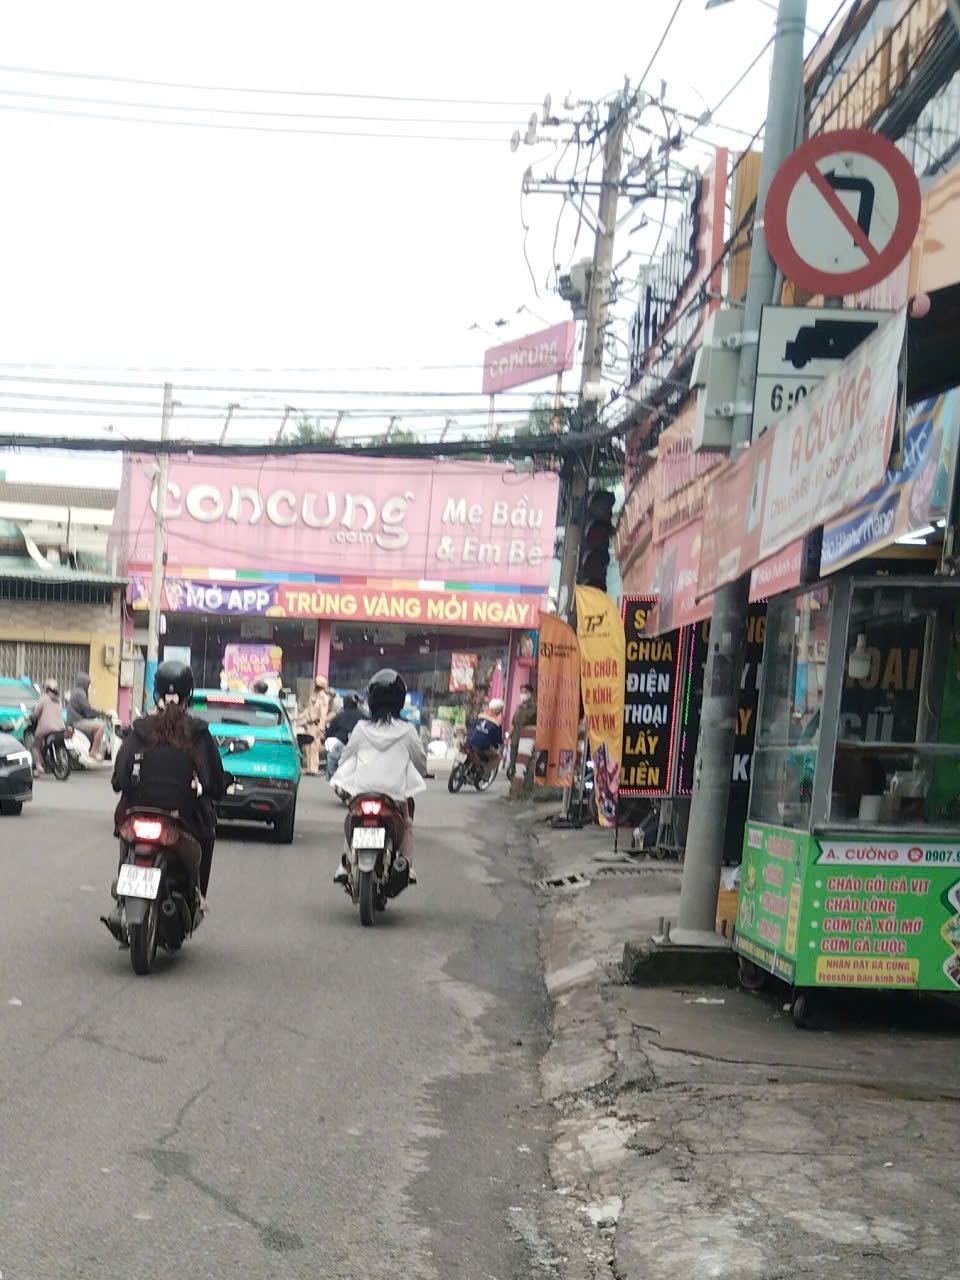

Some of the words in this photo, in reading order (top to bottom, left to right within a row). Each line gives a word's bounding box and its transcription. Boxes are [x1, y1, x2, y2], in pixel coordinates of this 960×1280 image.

[442, 497, 482, 533] Mẹ
[491, 494, 543, 529] Bầu
[435, 536, 454, 562] &
[462, 537, 501, 565] Em
[507, 539, 542, 567] Bé
[228, 588, 270, 612] APP
[363, 592, 422, 619] VÀNG
[473, 599, 530, 624] NGÀY
[626, 638, 673, 662] CHỮA
[626, 668, 670, 698] ĐIỆN
[624, 703, 668, 728] THOẠI
[625, 729, 659, 755] LẤY
[620, 760, 660, 787] LIỀN
[845, 846, 899, 861] CƯỜNG
[827, 874, 862, 892] CHÁO
[890, 875, 907, 893] GÀ
[911, 879, 931, 896] VỊT
[825, 895, 859, 913] CHÁO
[862, 896, 896, 914] LÒNG
[823, 918, 852, 933] CƠM
[855, 915, 872, 933] GÀ
[821, 939, 850, 952] CƠM
[853, 936, 871, 953] GÀ
[873, 939, 907, 958] LUỘC
